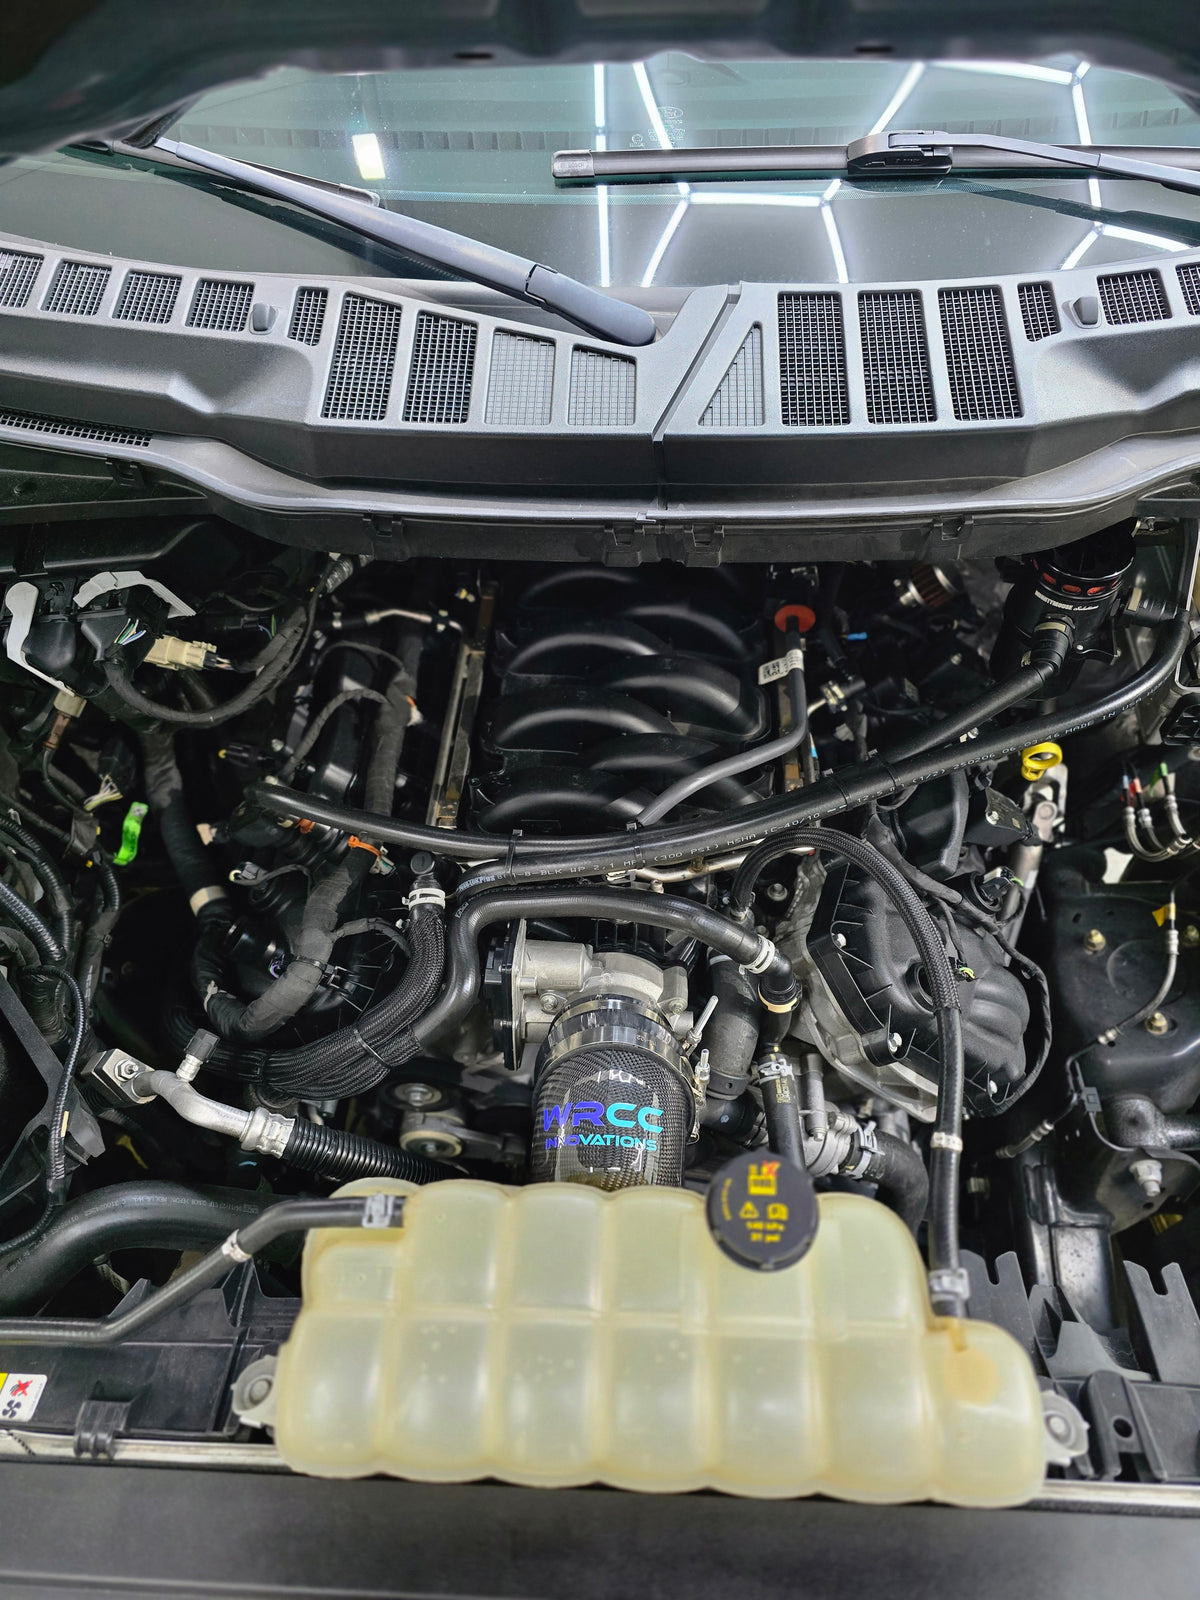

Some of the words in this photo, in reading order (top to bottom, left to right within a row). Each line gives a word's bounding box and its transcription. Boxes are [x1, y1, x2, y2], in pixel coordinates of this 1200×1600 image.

[1065, 719, 1095, 734] MADE
[1102, 711, 1116, 721] IN
[1122, 697, 1142, 711] USA
[544, 1101, 664, 1134] WRCC
[545, 1133, 658, 1151] INNOVATIONS
